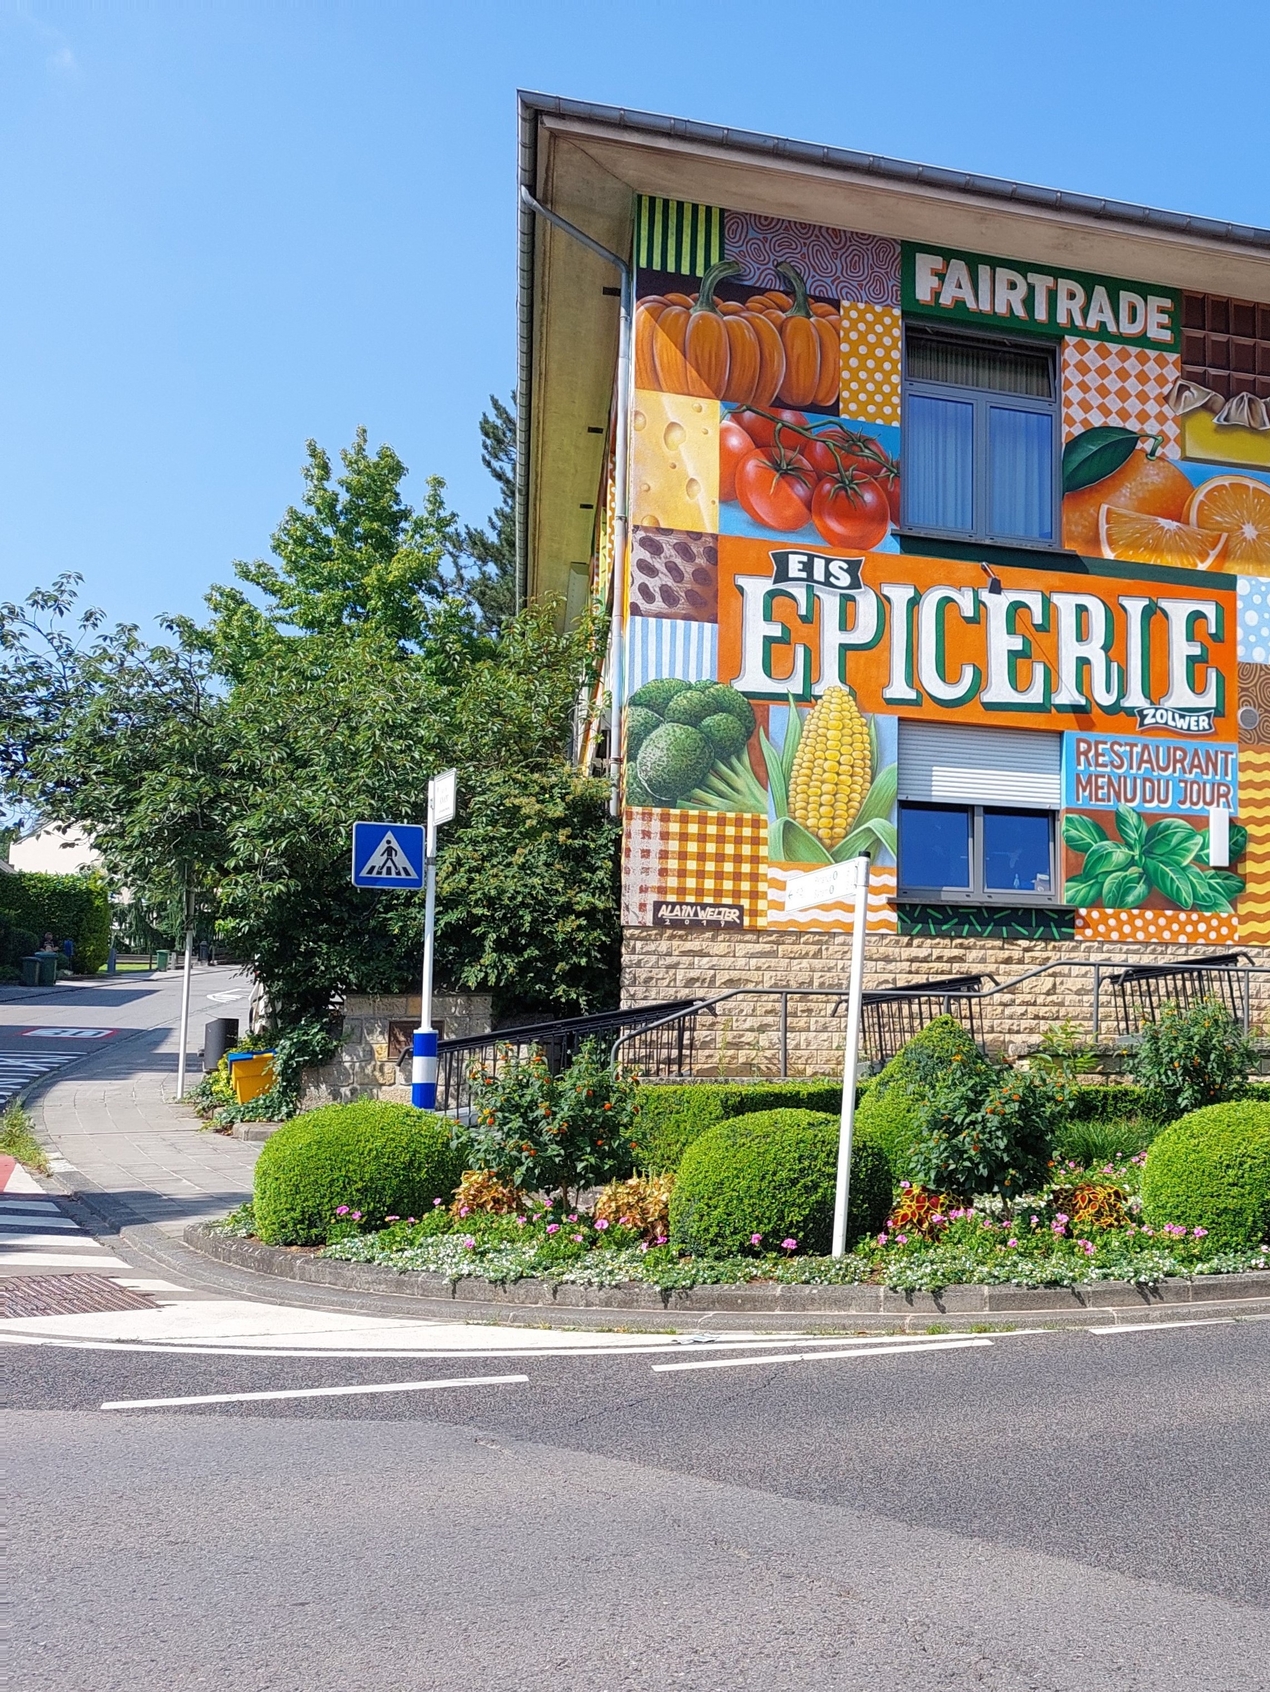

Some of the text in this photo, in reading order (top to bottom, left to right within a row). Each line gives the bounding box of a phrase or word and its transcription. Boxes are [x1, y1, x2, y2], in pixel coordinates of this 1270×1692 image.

[915, 252, 1174, 344] FAIRTRADE
[788, 555, 851, 587] EIS
[731, 574, 1224, 716] EPICERIE
[1143, 709, 1210, 730] ZOLWER
[1075, 738, 1235, 780] RESTAURANT
[1075, 773, 1234, 810] MENU DU JOUR
[697, 905, 740, 923] WELTER
